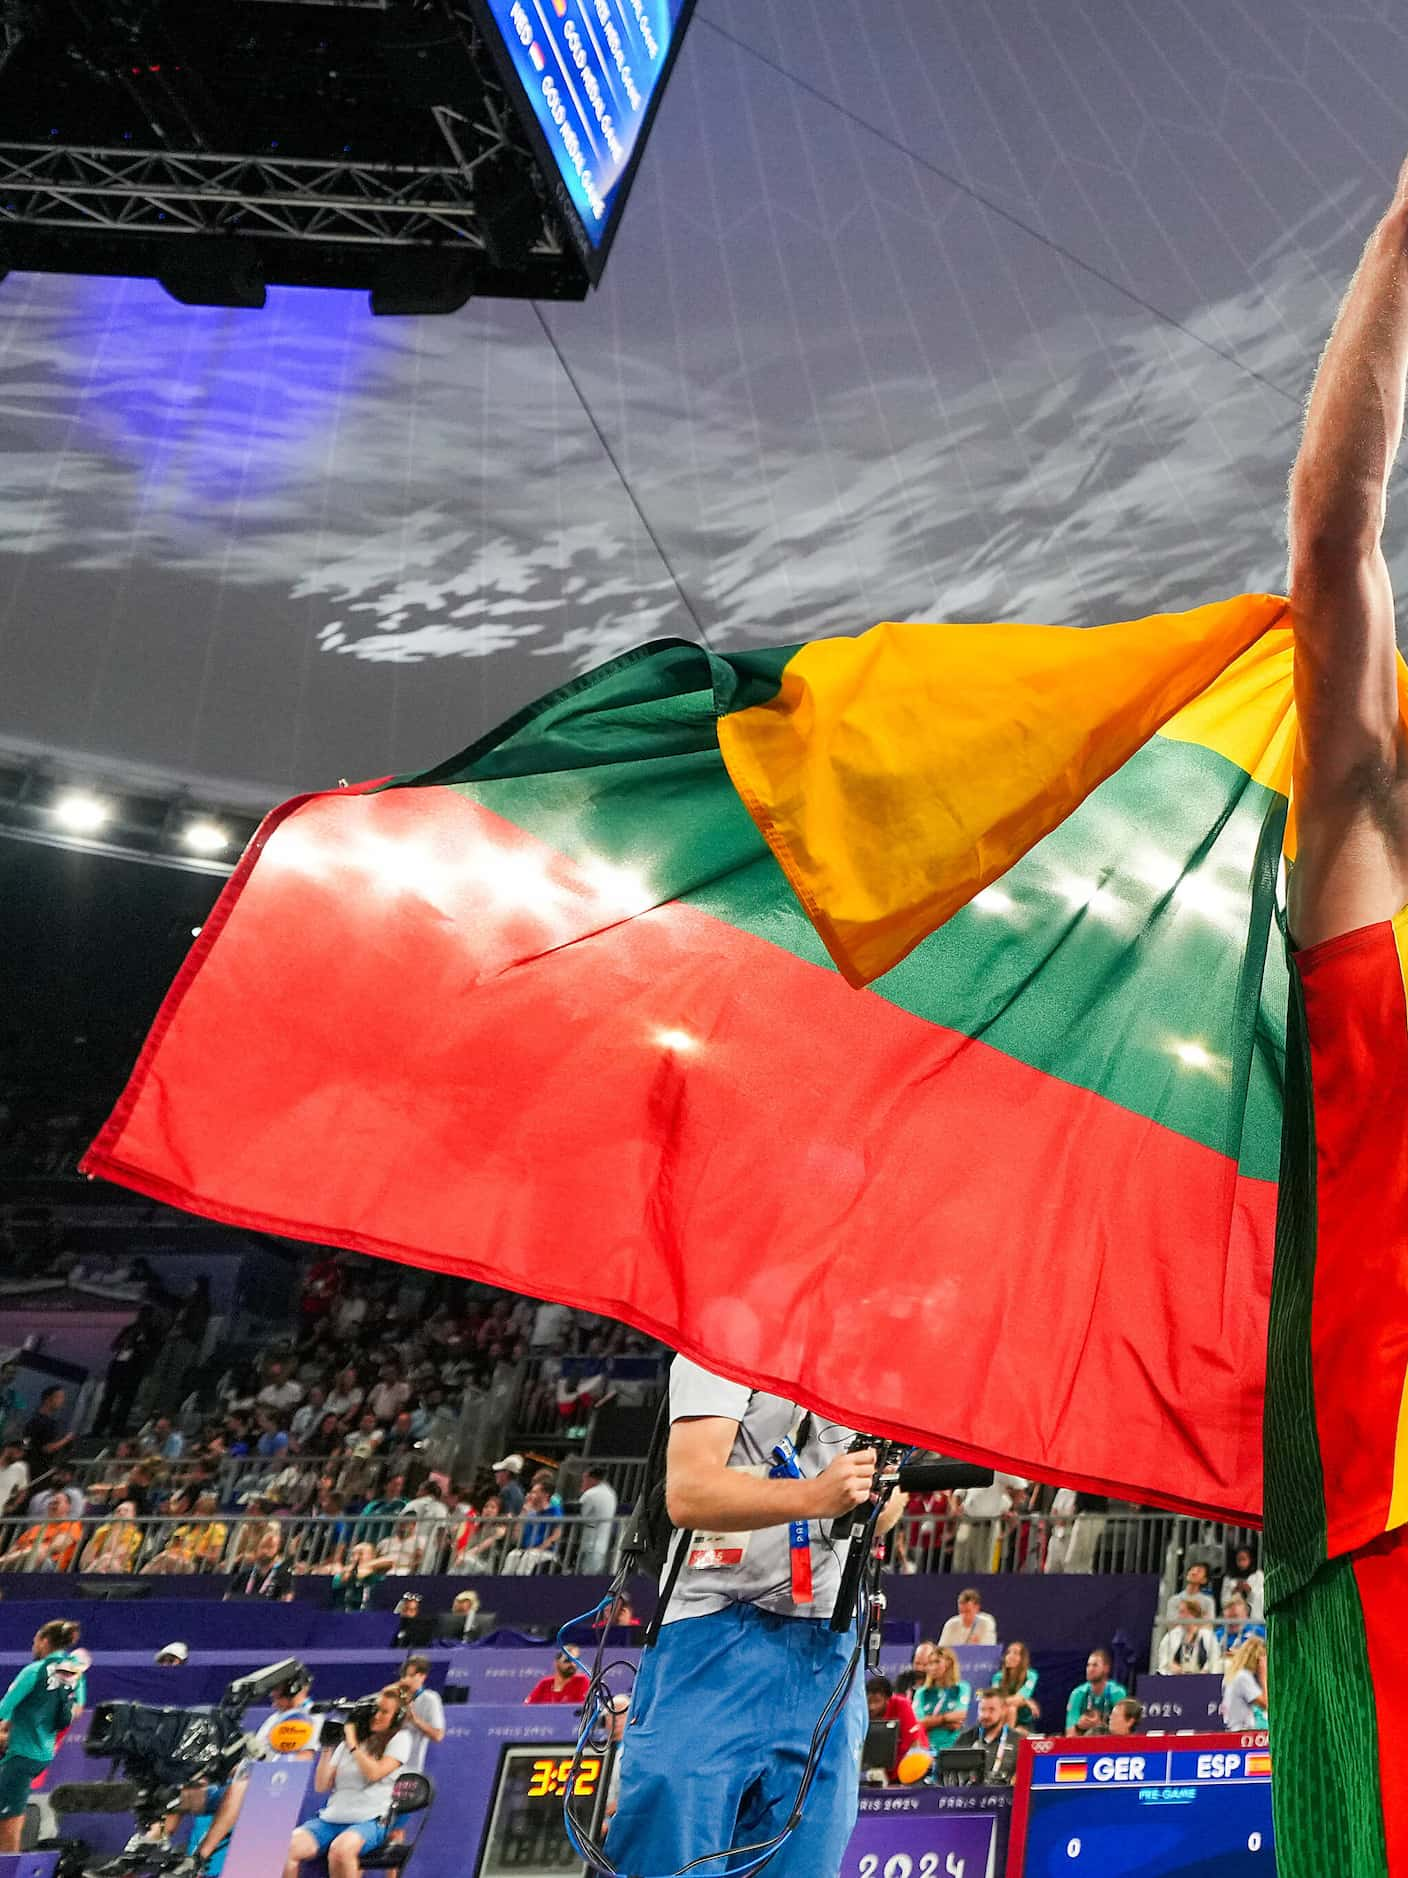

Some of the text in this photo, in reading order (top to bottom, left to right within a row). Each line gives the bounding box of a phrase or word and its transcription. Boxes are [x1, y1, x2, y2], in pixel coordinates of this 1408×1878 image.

[564, 20, 587, 69] GOLD
[580, 65, 606, 121] MEDAL
[542, 75, 566, 125] GOLD
[559, 120, 586, 176] MEDAL
[1141, 1702, 1183, 1719] 2024
[1093, 1756, 1146, 1782] GER
[1197, 1753, 1241, 1778] ESP
[527, 1759, 601, 1797] 3:52
[860, 1797, 920, 1811] RIS 2024
[938, 1796, 976, 1809] PARIS
[1138, 1788, 1198, 1801] PRE-GAME
[1066, 1838, 1081, 1858] 0
[1248, 1832, 1262, 1852] 0
[858, 1852, 966, 1878] 2024
